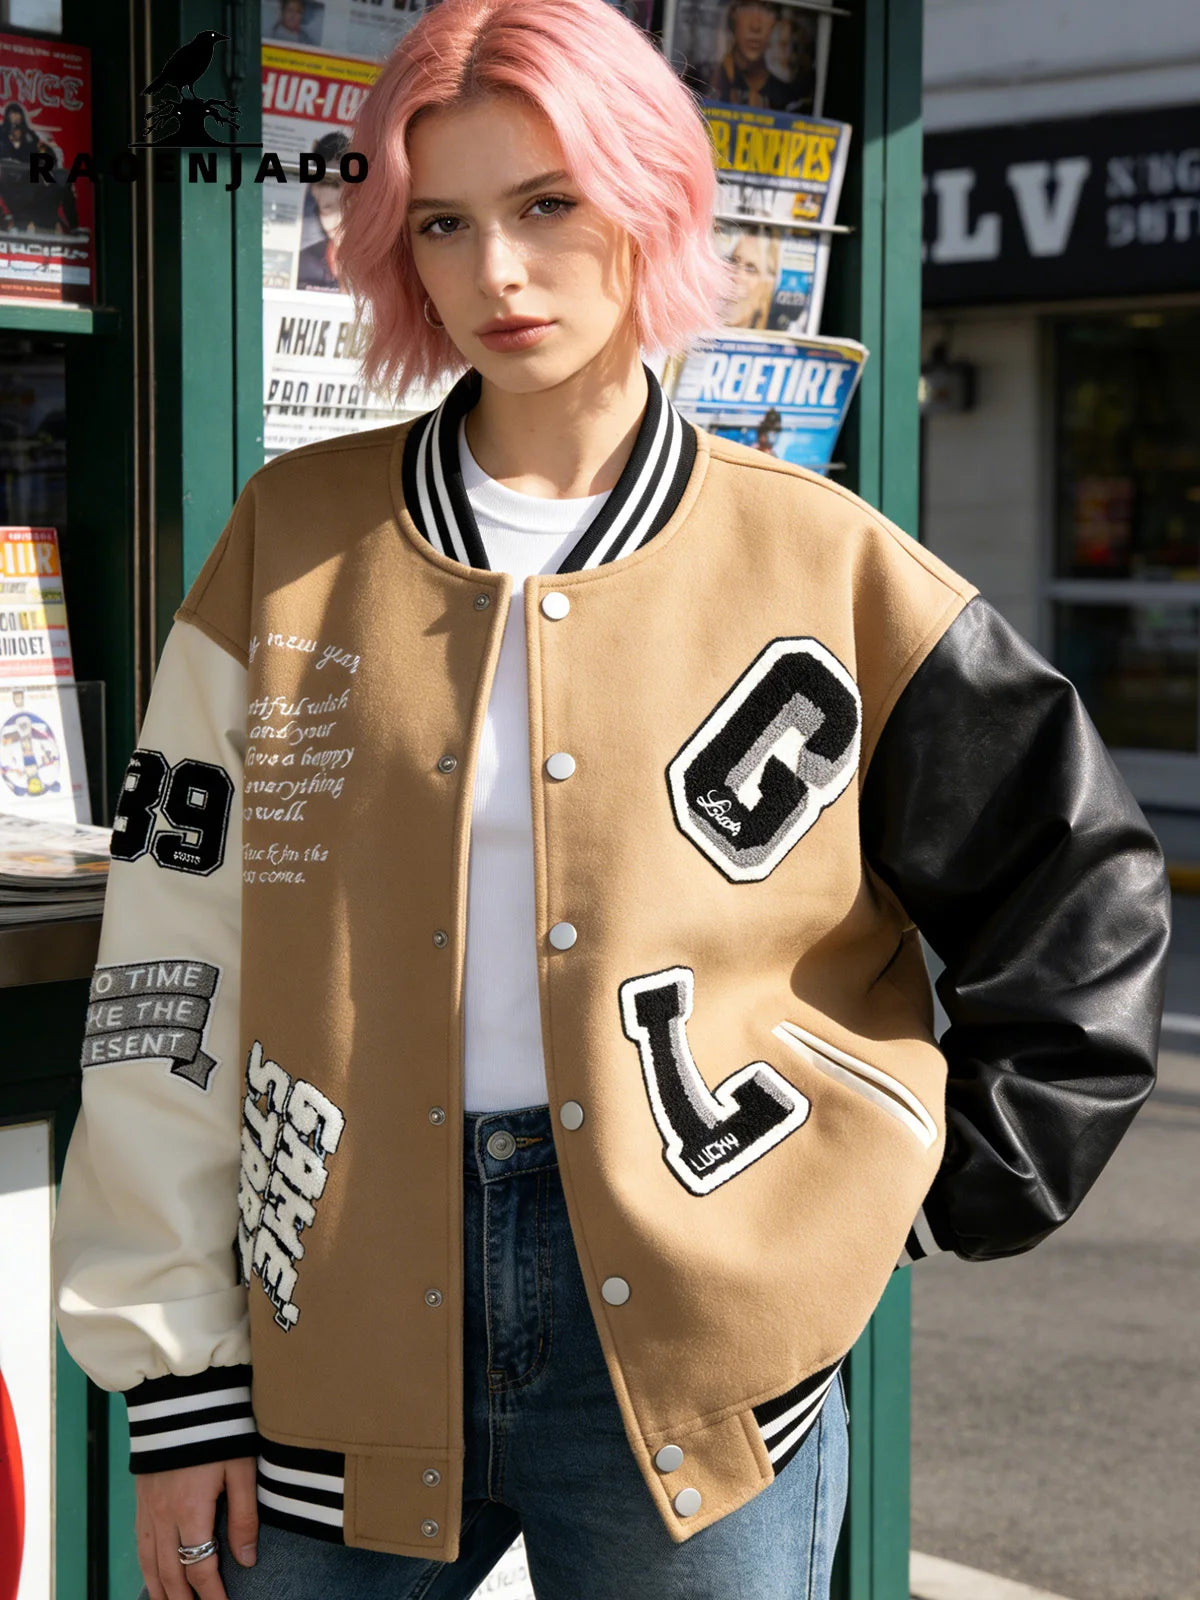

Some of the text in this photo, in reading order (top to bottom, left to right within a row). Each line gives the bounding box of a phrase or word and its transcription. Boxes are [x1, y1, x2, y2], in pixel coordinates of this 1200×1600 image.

[922, 156, 1090, 264] LV
[125, 962, 203, 990] TIME
[136, 1000, 194, 1022] THE
[91, 1032, 186, 1061] ESENT
